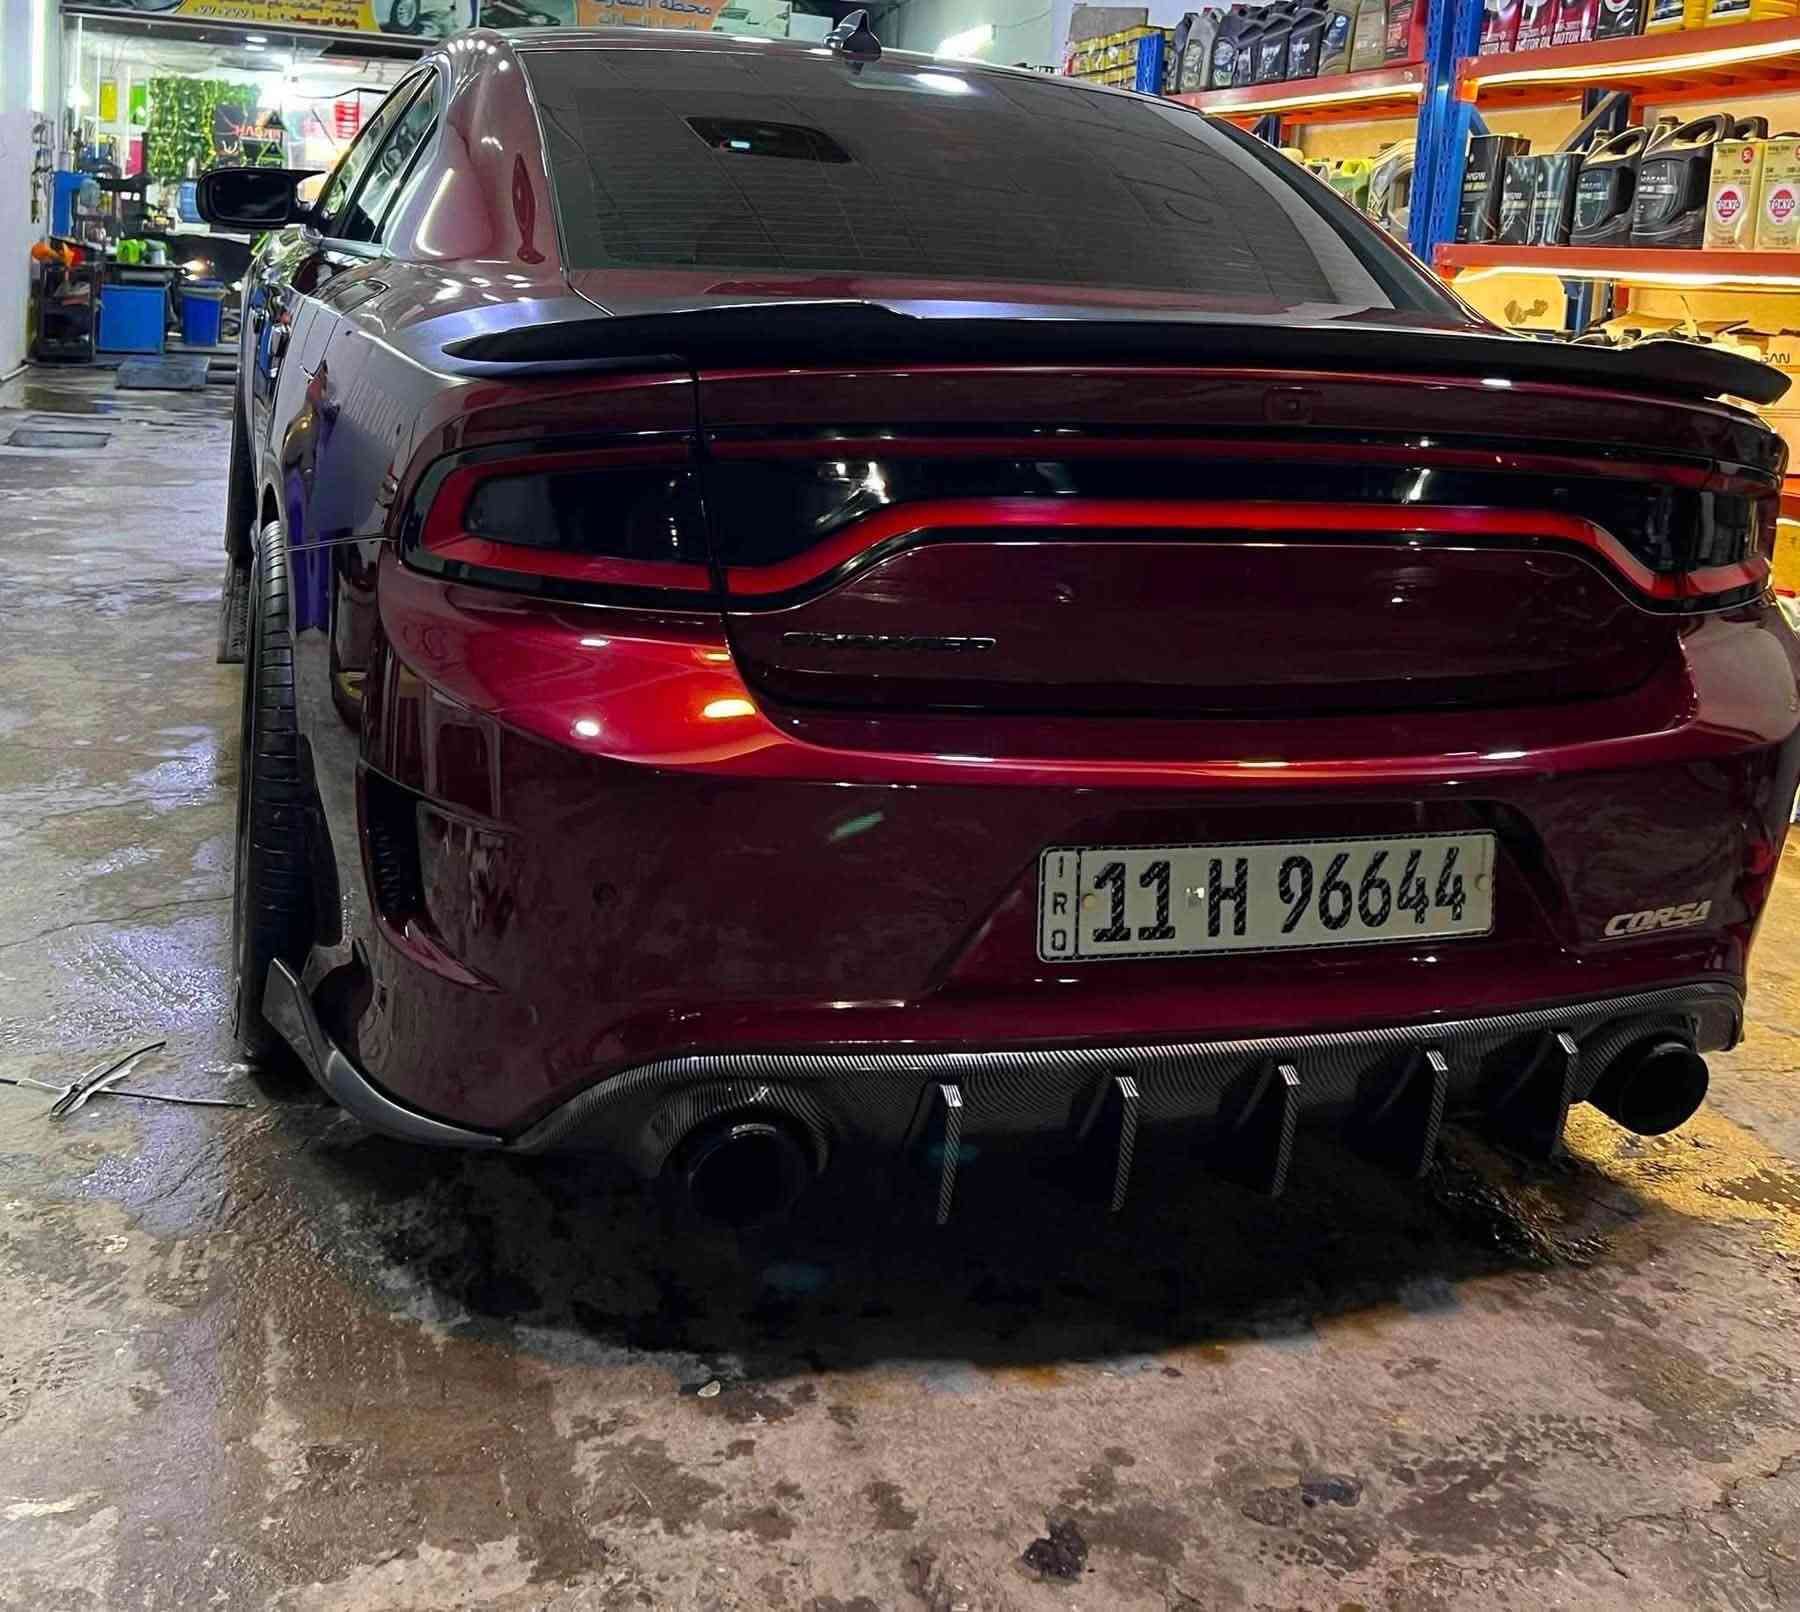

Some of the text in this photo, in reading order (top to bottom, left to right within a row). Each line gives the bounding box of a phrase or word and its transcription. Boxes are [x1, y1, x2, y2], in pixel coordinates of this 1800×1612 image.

[1769, 200, 1796, 209] TOKYO
[1093, 847, 1466, 942] 11 H 96644
[1604, 900, 1712, 937] CORSA
